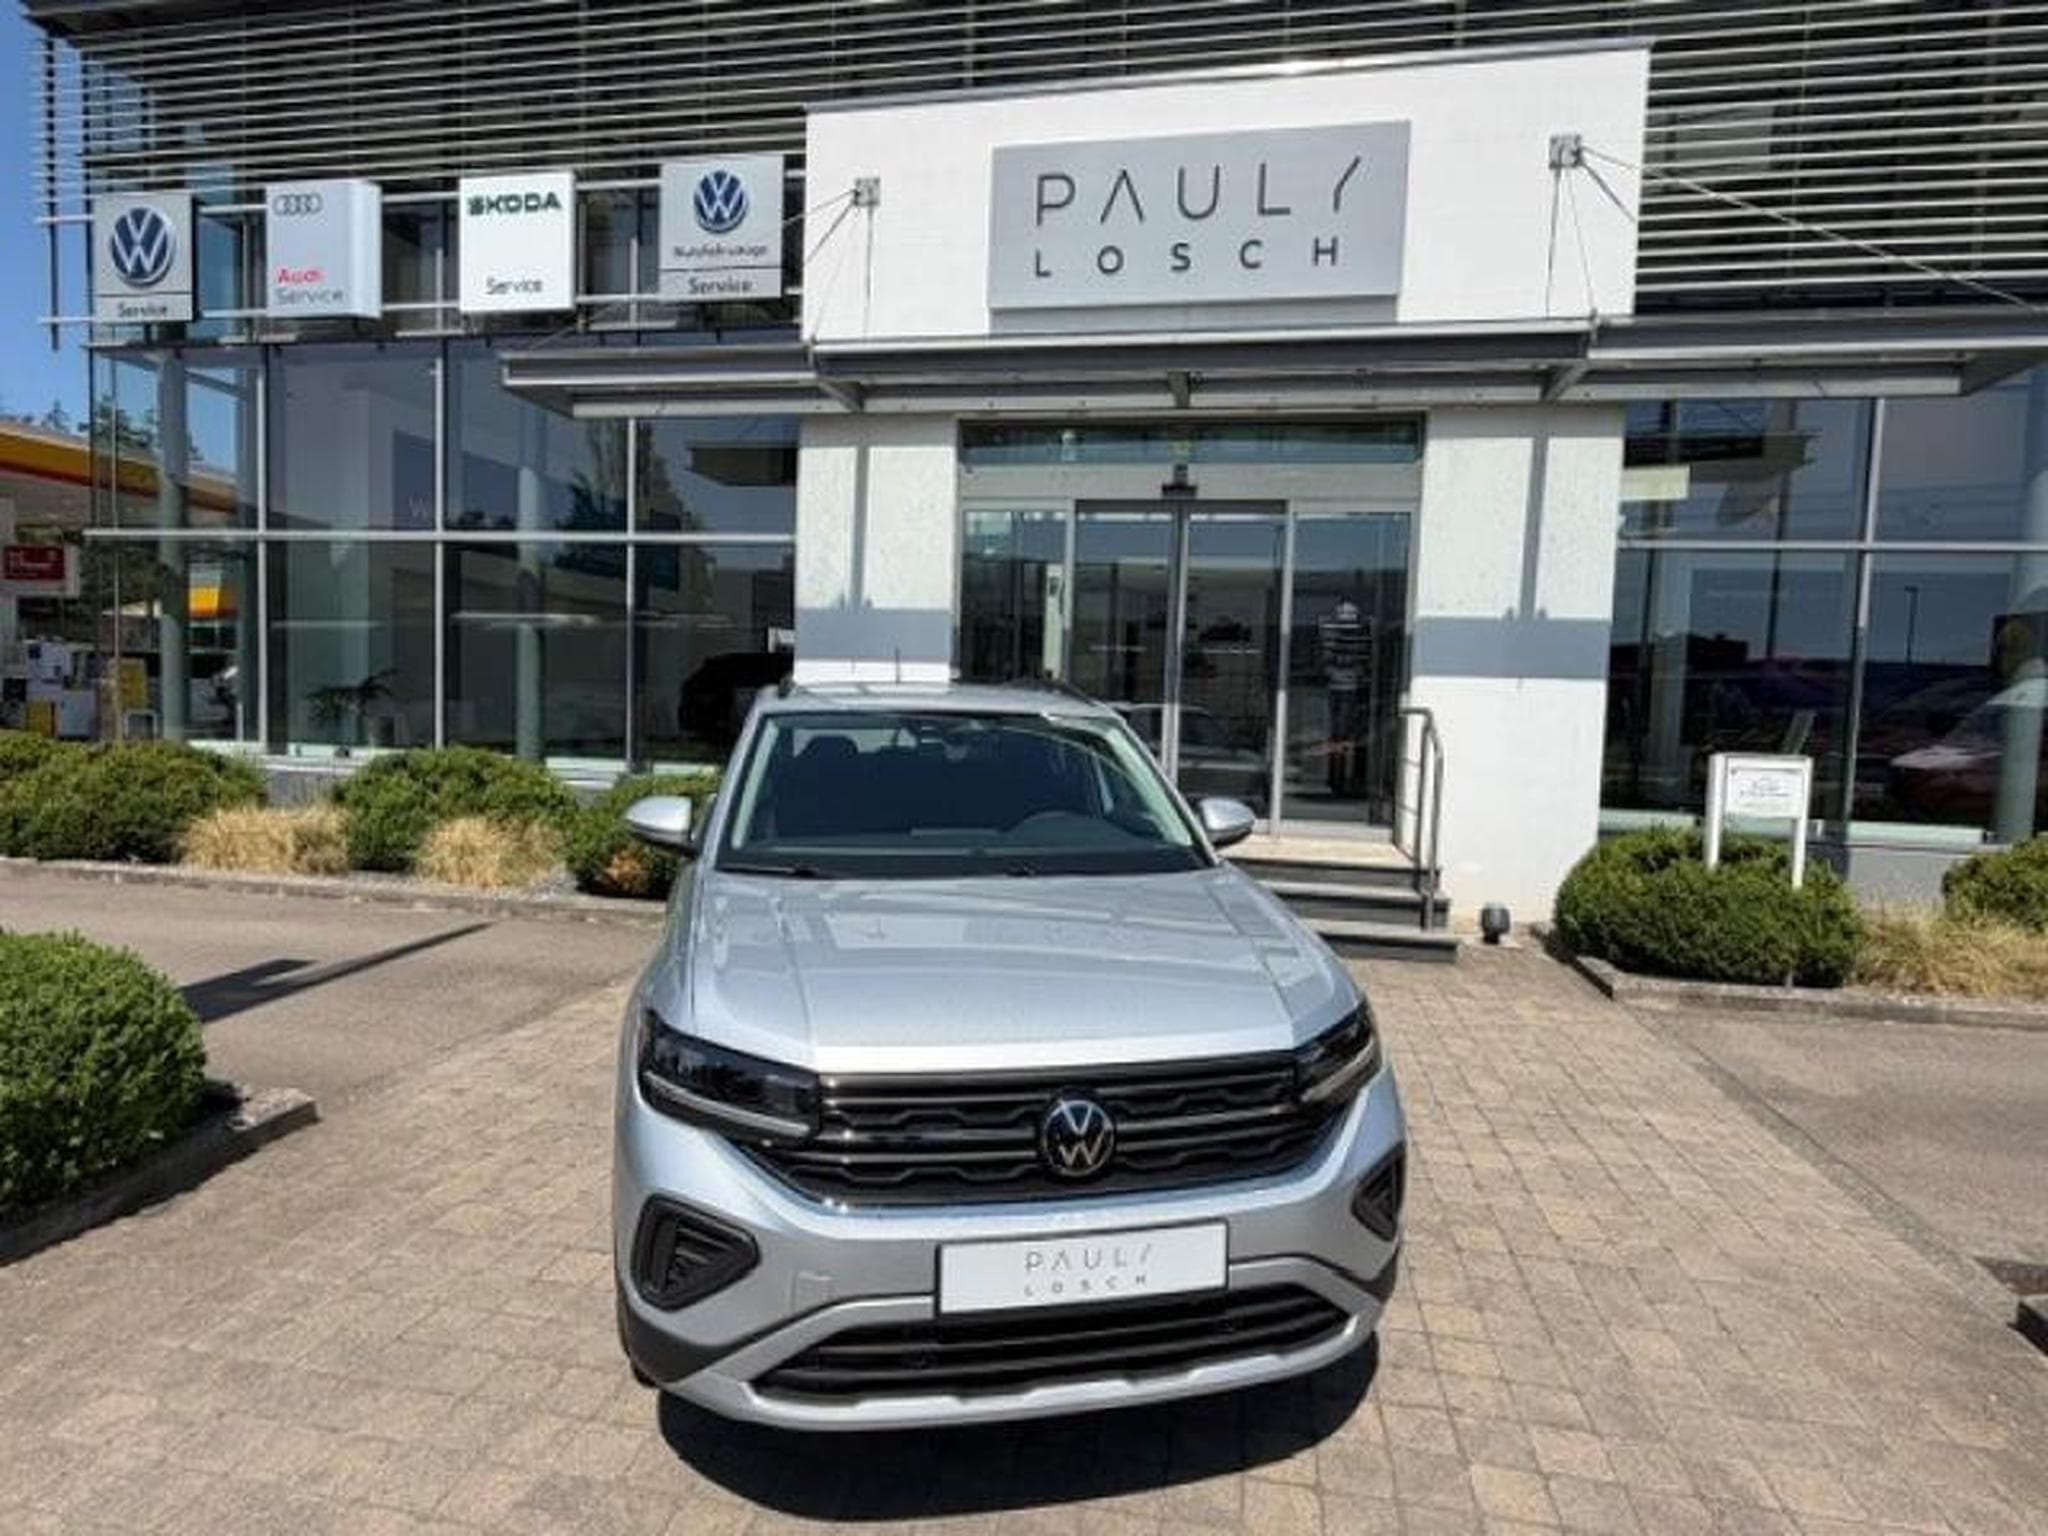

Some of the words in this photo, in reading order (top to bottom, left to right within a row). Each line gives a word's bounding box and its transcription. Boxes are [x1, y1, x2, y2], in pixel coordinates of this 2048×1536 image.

[1034, 156, 1362, 227] PAULY
[1034, 236, 1339, 279] LOSCH
[277, 268, 327, 284] Audi
[486, 275, 543, 296] Service
[687, 276, 753, 295] Service
[274, 287, 345, 305] Service
[117, 301, 168, 318] Service
